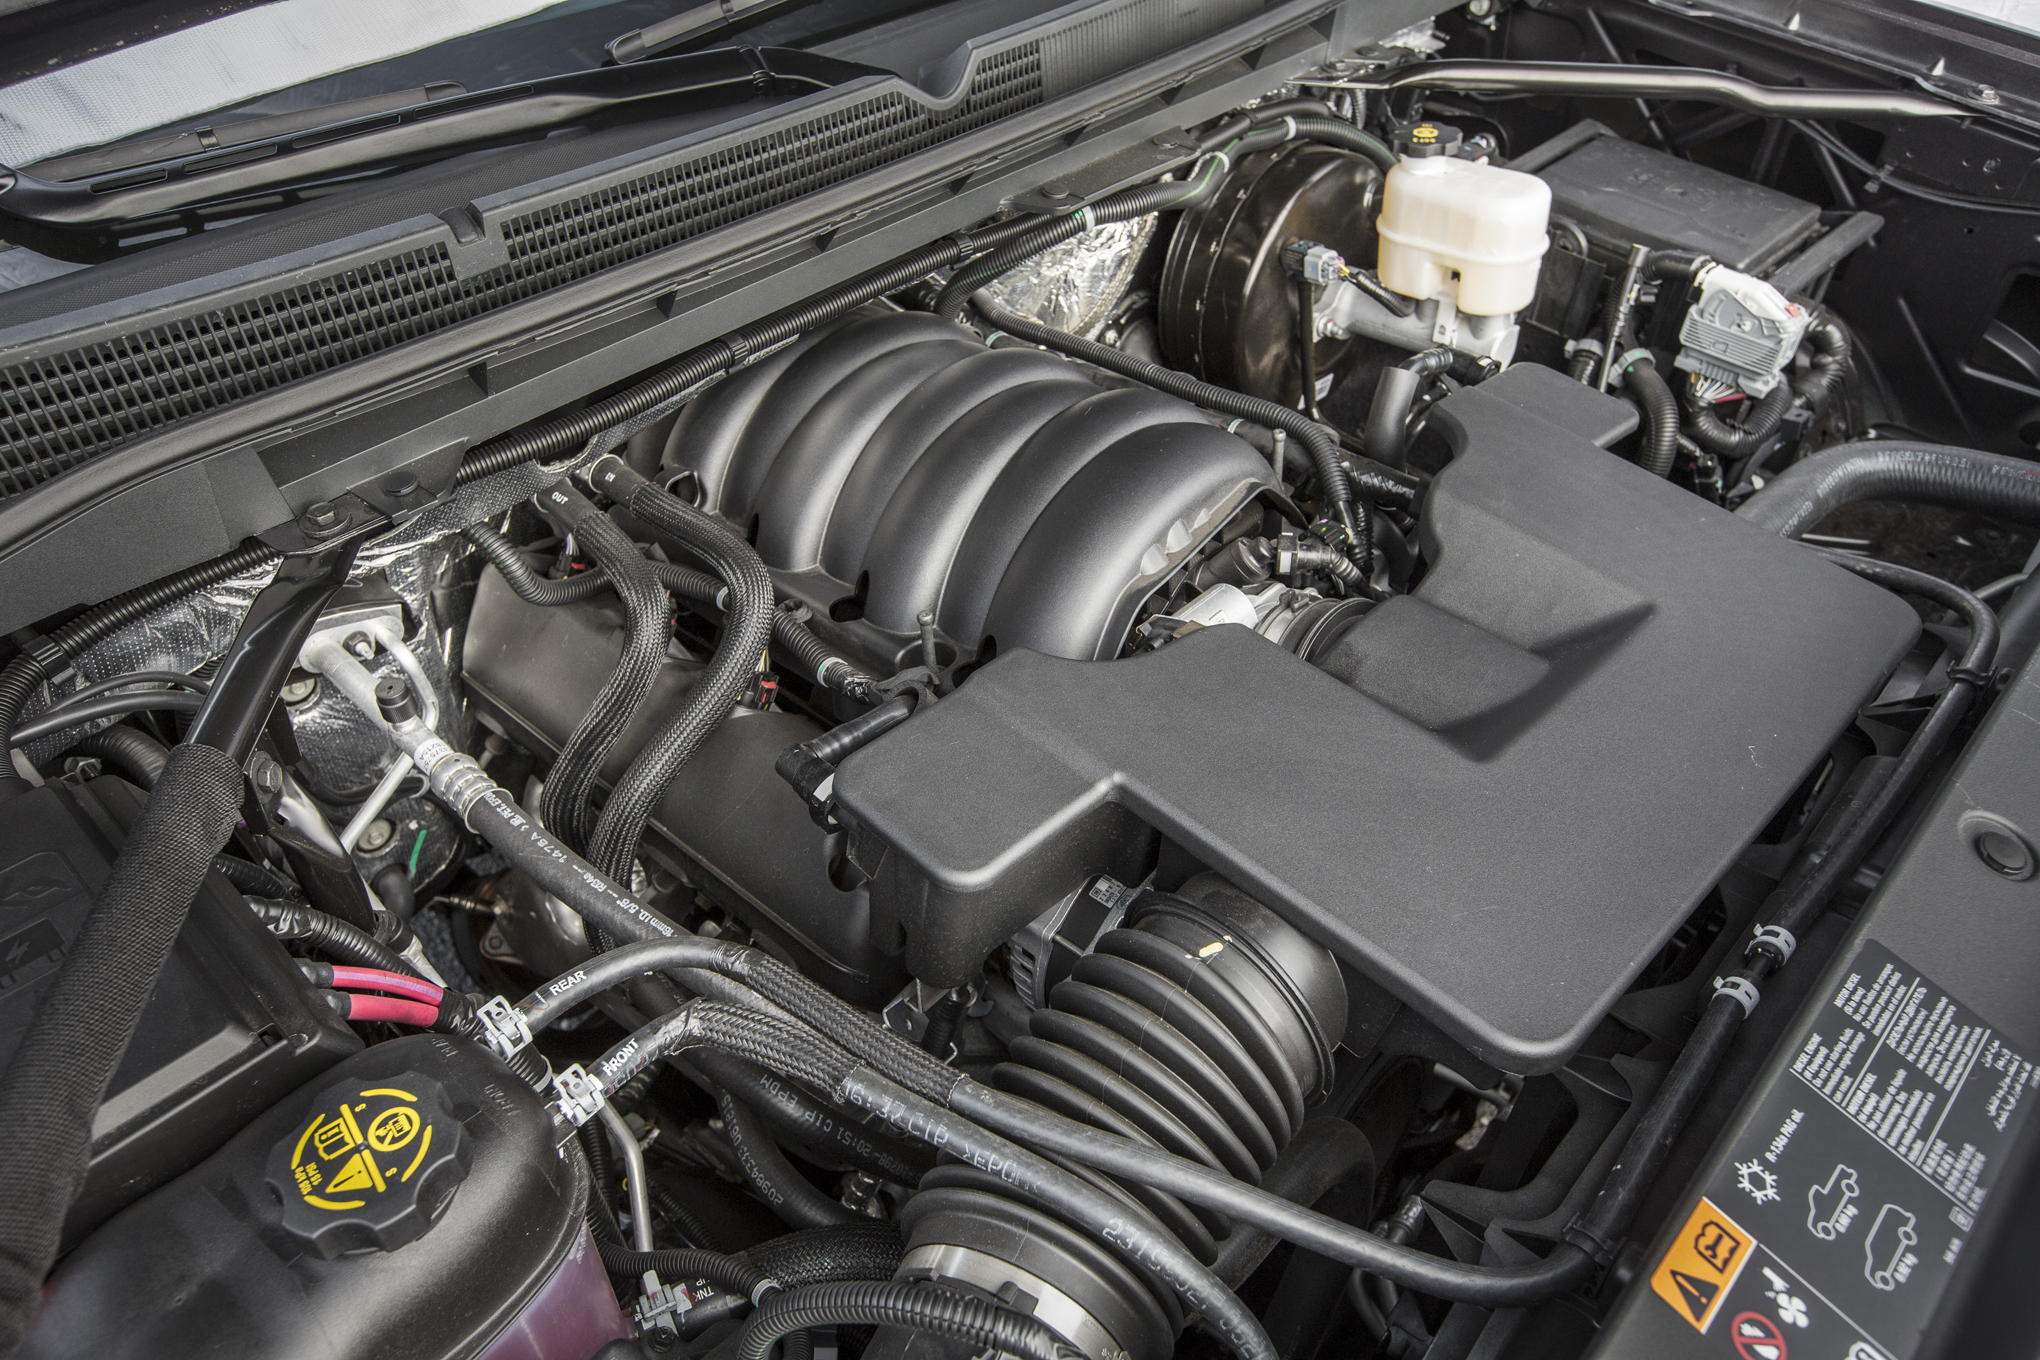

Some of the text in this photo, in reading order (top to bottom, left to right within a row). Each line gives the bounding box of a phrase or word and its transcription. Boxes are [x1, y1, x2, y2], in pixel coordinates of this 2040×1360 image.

[551, 491, 568, 505] OUT
[549, 970, 587, 996] REAR
[1832, 970, 1861, 1008] MOTOR DIESEL
[1860, 1018, 1873, 1030] Se
[602, 1038, 639, 1076] FRONT
[1791, 1031, 1823, 1073] DIESEL ENGINE
[1805, 1044, 1830, 1074] Equipped)
[1820, 1065, 1844, 1096] Immediate
[1846, 1030, 1868, 1054] damage
[1827, 1040, 1847, 1063] starting
[1816, 1067, 1829, 1080] not
[1822, 1058, 1835, 1071] use
[756, 1073, 801, 1108] EPDM
[1811, 1075, 1824, 1088] Do
[1845, 1070, 1877, 1116] MOTEUR DIESEL
[1831, 1089, 1845, 1103] can
[1763, 1132, 1789, 1163] R-134a
[1778, 1117, 1798, 1138] PAG
[304, 1161, 323, 1186] 15 PSI
[1841, 1202, 1860, 1219] kg
